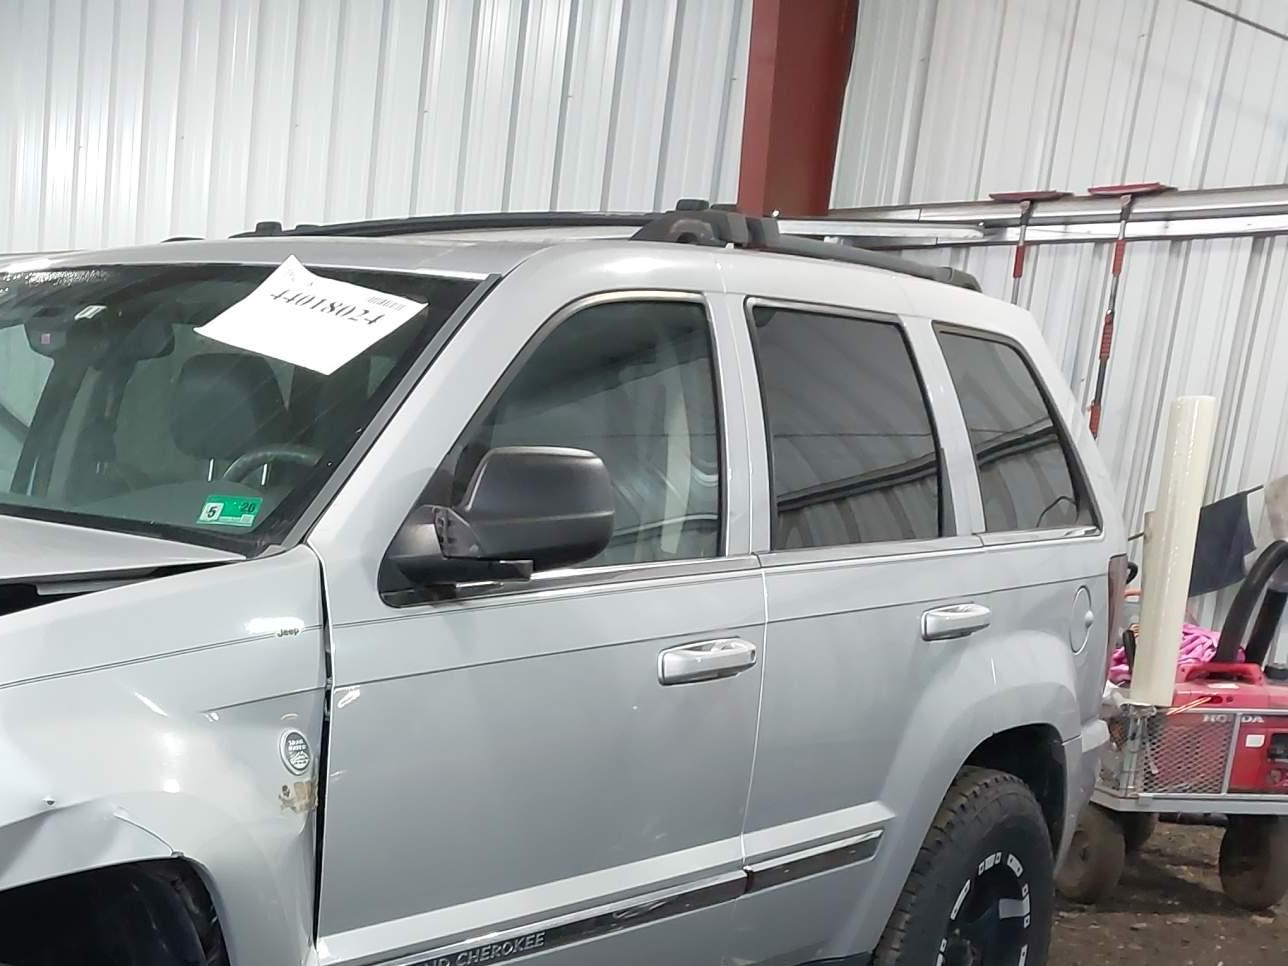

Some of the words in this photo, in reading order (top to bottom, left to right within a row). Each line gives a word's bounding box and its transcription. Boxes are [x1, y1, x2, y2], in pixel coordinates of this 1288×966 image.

[270, 289, 385, 325] 44018024
[207, 506, 218, 518] 5
[1203, 714, 1265, 723] HODA
